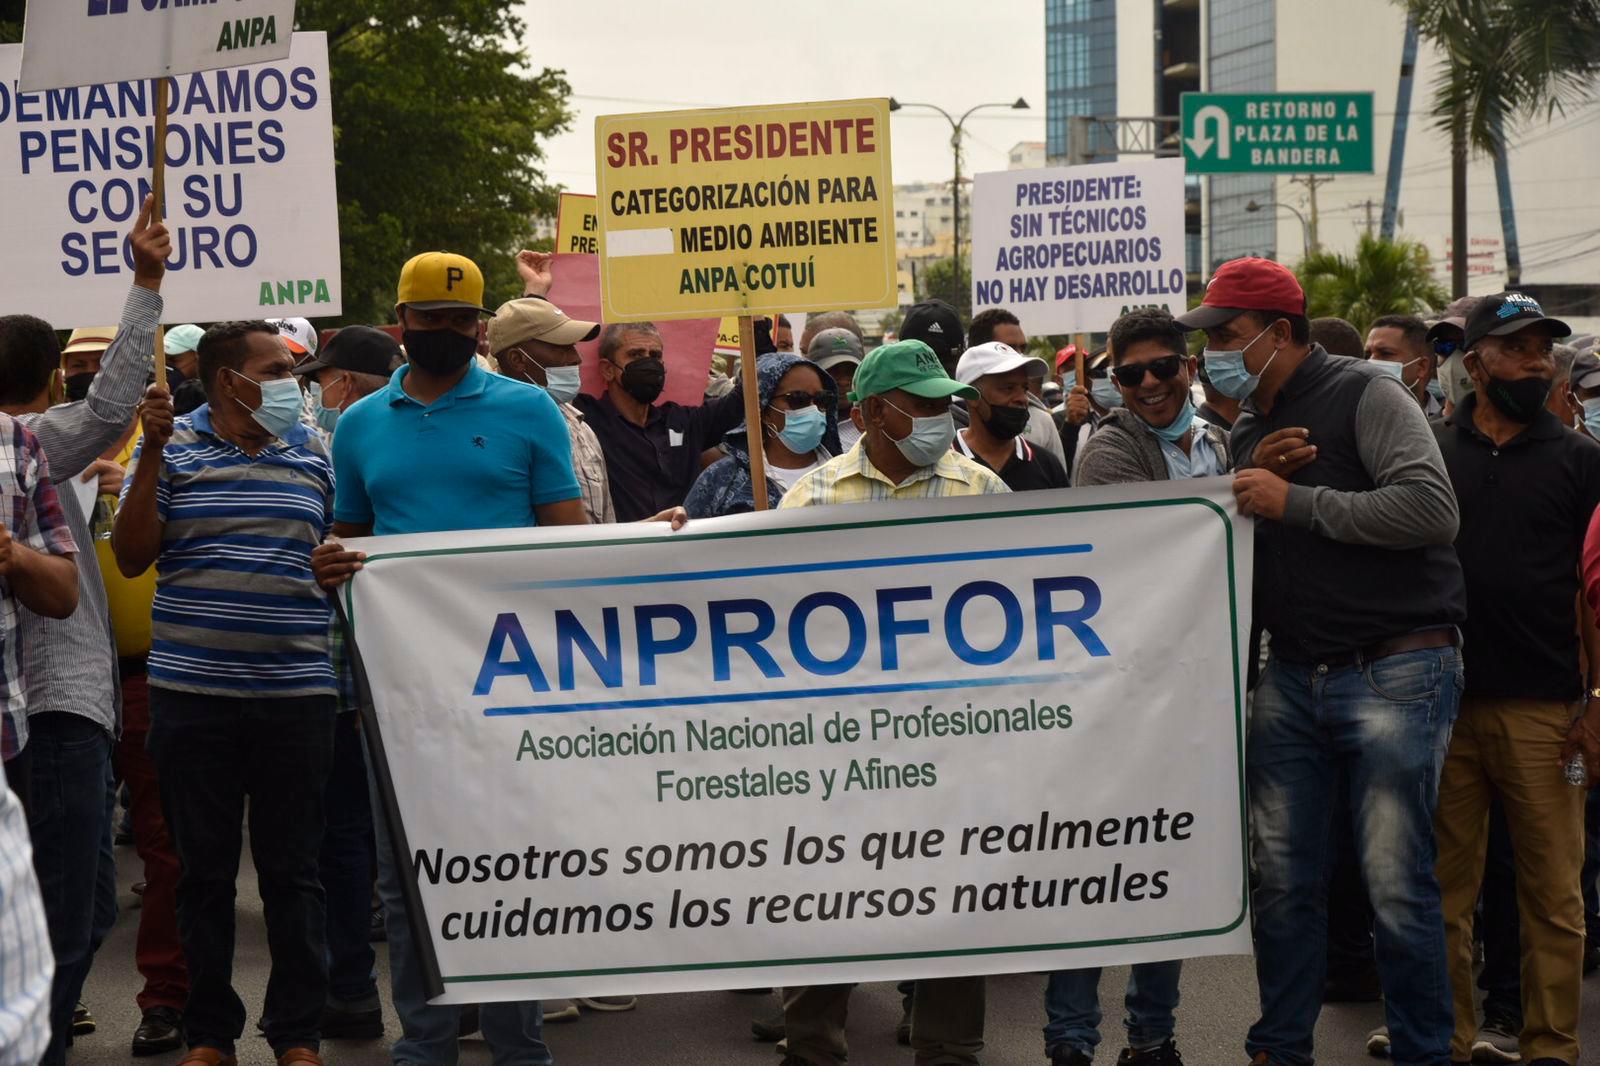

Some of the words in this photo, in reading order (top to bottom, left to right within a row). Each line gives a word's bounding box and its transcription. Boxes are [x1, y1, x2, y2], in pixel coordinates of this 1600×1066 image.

[217, 15, 277, 51] ANPA
[1246, 102, 1336, 119] RETORNO
[1346, 102, 1358, 119] A
[20, 118, 286, 174] PENSIONES
[607, 131, 658, 168] SR.
[670, 118, 876, 164] PRESIDENTE
[1235, 125, 1296, 142] PLAZA
[1305, 125, 1329, 142] DE
[1335, 125, 1358, 142] LA
[1251, 147, 1340, 165] BANDERA
[184, 173, 243, 218] SU
[611, 174, 810, 217] CATEGORIZACIÓN
[818, 175, 878, 204] PARA
[1016, 174, 1142, 207] PRESIDENTE:
[681, 224, 752, 253] MEDIO
[760, 217, 878, 249] AMBIENTE
[1010, 213, 1042, 239] SIN
[1049, 205, 1147, 236] TÉCNICOS
[571, 235, 599, 254] PRE
[996, 236, 1161, 272] AGROPECUARIOS
[259, 279, 331, 306] ANPA
[446, 267, 464, 290] P
[679, 265, 739, 295] ANPA
[745, 256, 815, 291] COTUÍ
[976, 279, 1004, 306] NO
[1009, 276, 1048, 303] HAY
[1054, 268, 1184, 301] DESARROLLO
[471, 576, 1111, 695] ANPROFOR
[516, 722, 676, 761] Asociación
[686, 713, 814, 751] Nacional
[824, 711, 860, 744] de
[870, 699, 1073, 741] Profesionales
[657, 764, 811, 802] Forestales
[819, 768, 837, 801] y
[844, 758, 937, 792] Afines
[413, 845, 609, 885] Nosotros
[622, 836, 768, 875] somos
[783, 826, 845, 866] los
[861, 828, 945, 870] que
[960, 807, 1195, 856] realmente
[441, 897, 654, 941] cuidamos
[669, 889, 731, 929] los
[746, 884, 937, 925] recursos
[952, 863, 1169, 914] naturales
